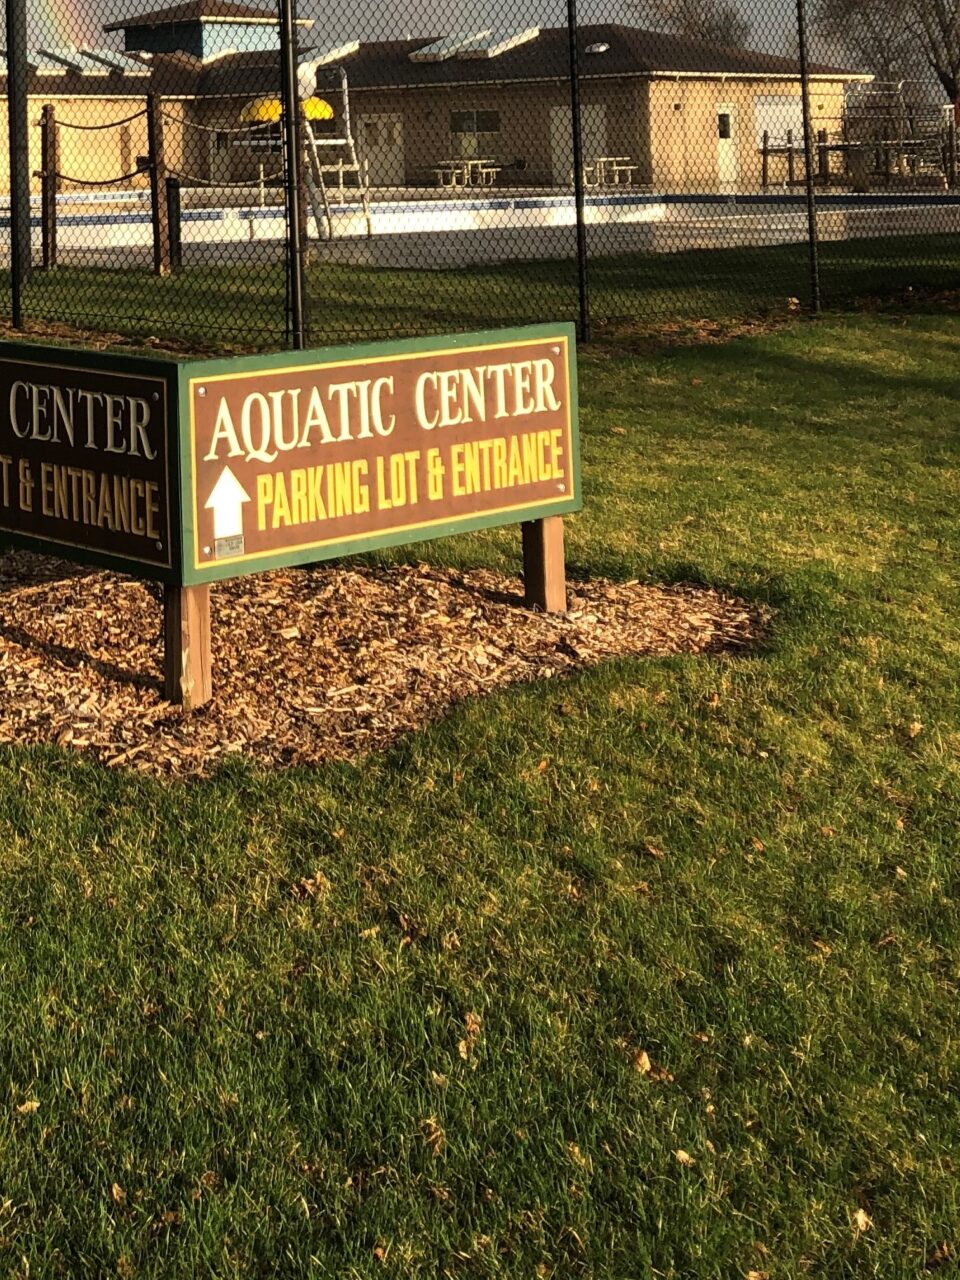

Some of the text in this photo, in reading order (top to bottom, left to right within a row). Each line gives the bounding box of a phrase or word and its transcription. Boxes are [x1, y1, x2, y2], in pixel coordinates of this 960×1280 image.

[9, 380, 157, 460] CENTER
[203, 358, 562, 463] AQUATIC CENTER
[19, 458, 35, 512] &
[41, 462, 160, 539] ENTRANCE
[256, 429, 564, 531] PARKING LOT & ENTRANCE
